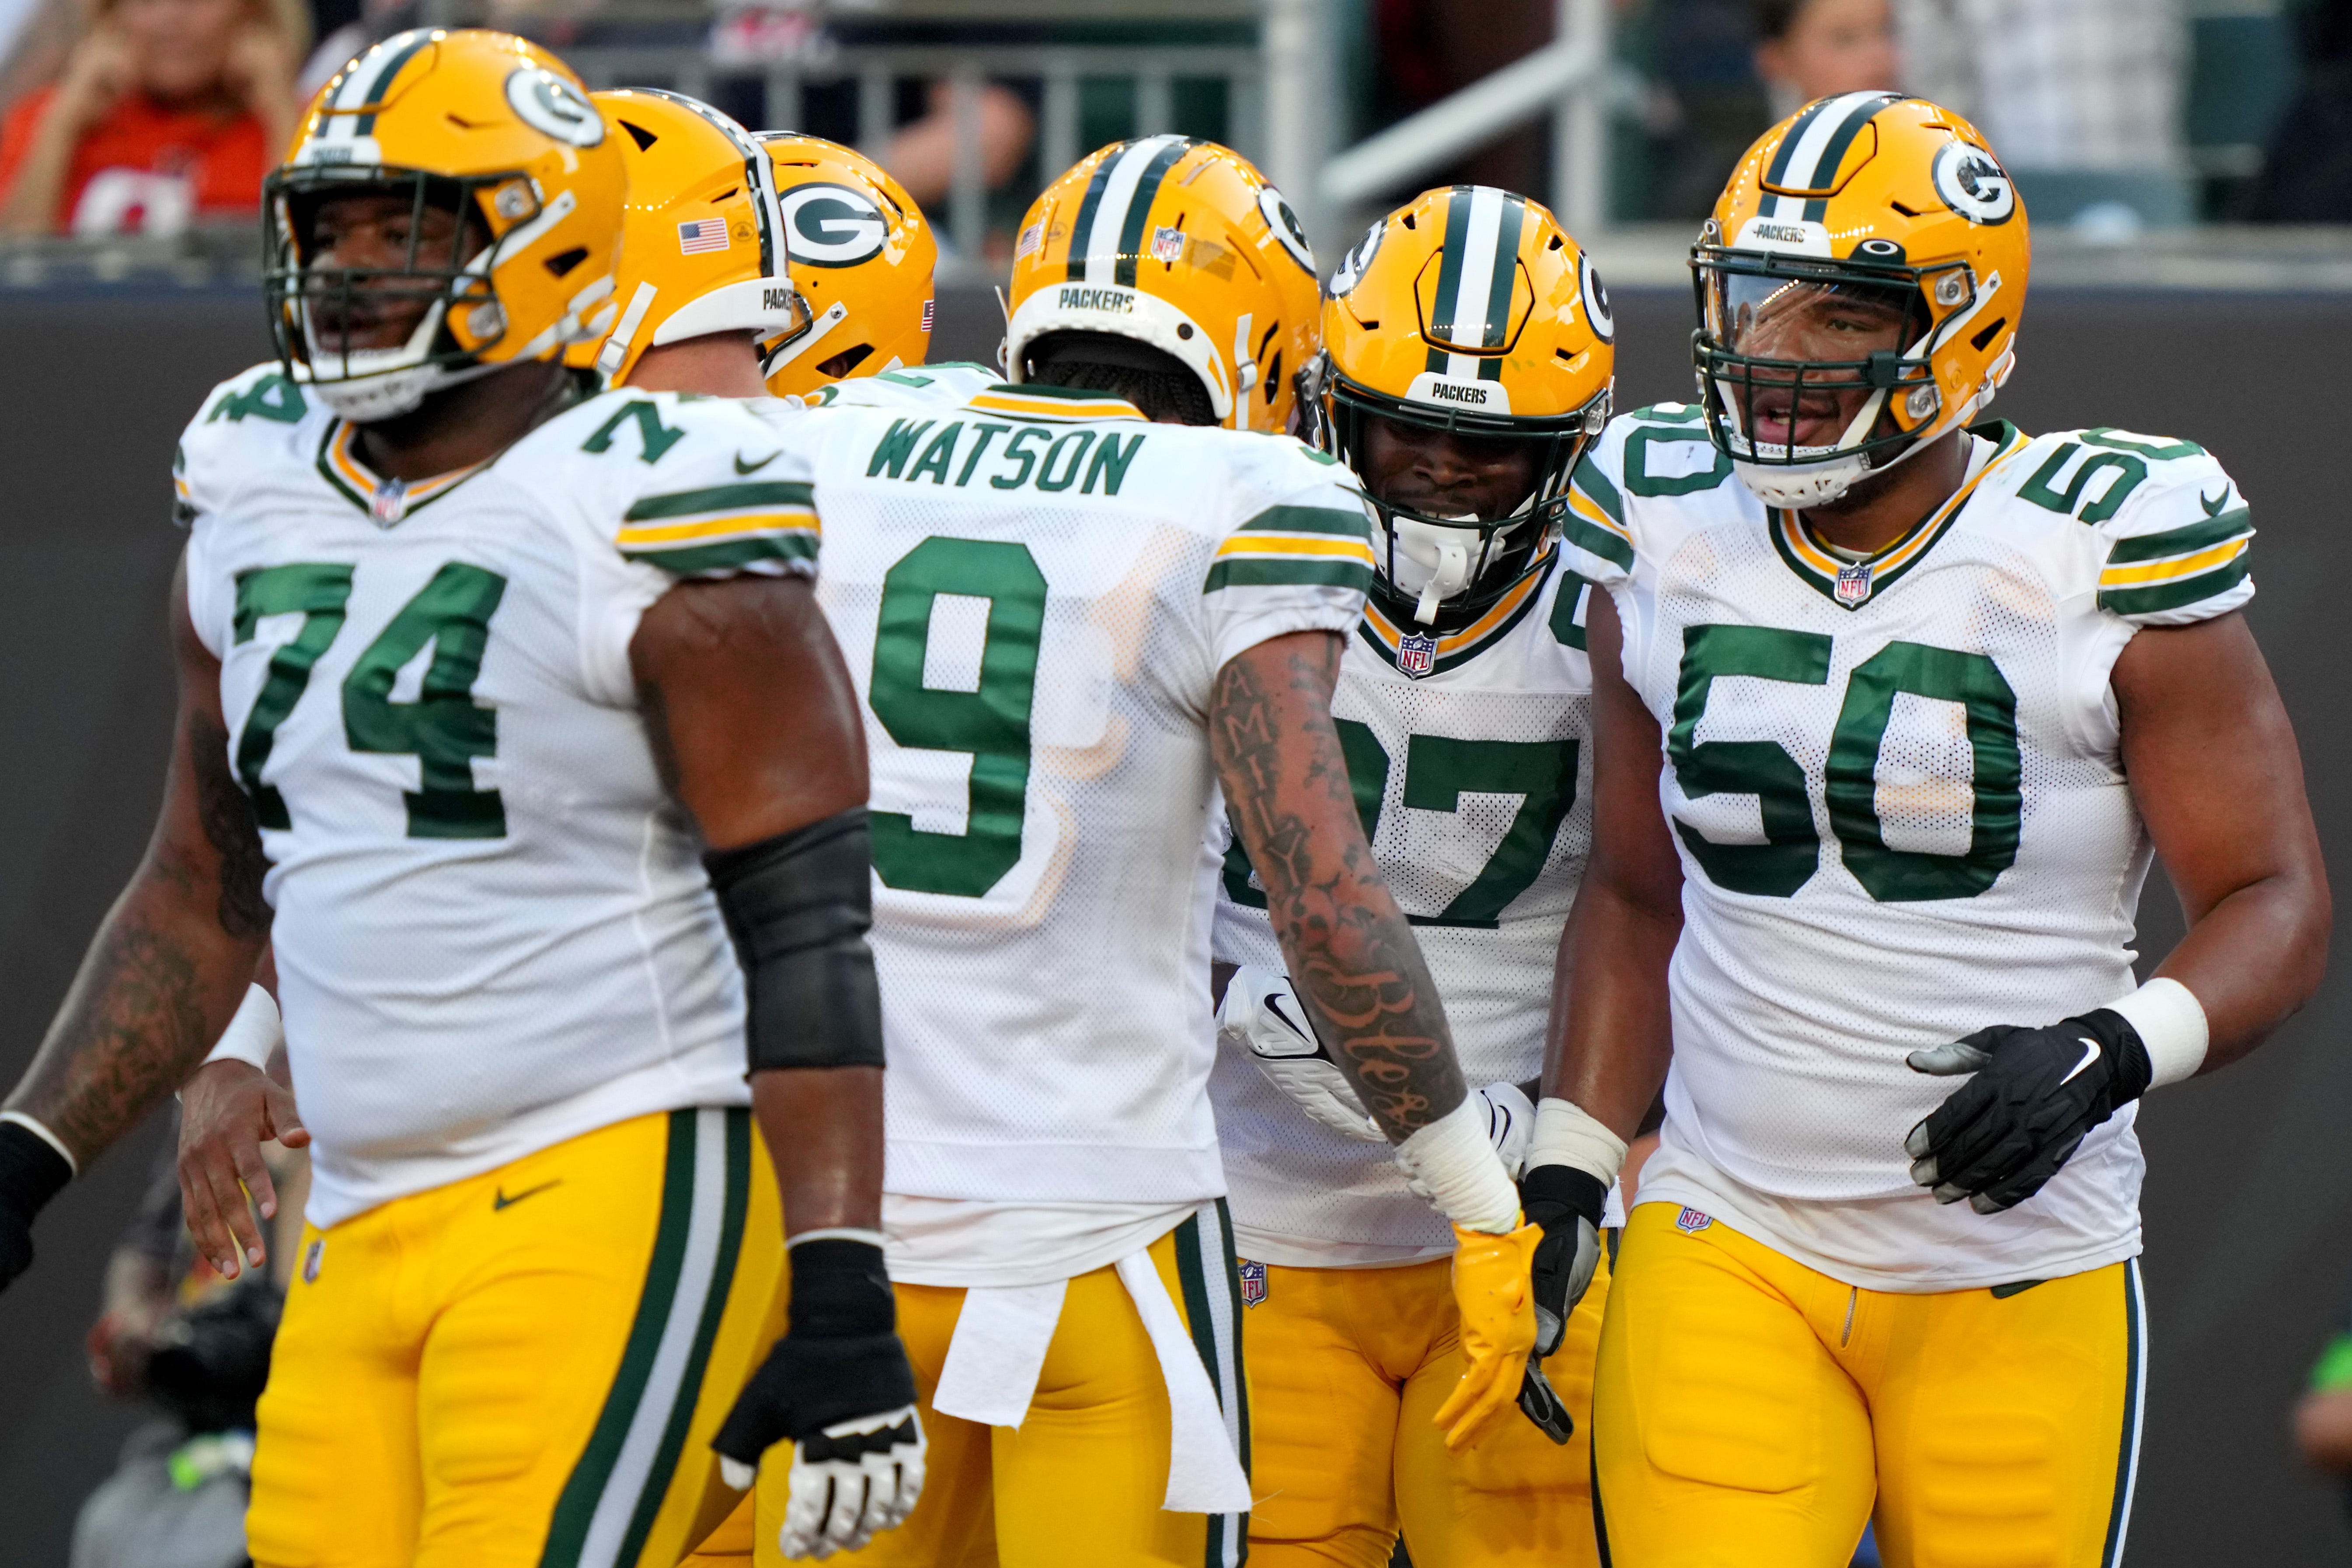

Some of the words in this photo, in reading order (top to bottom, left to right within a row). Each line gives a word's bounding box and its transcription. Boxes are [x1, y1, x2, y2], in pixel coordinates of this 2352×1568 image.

[780, 184, 888, 265] G
[763, 288, 793, 310] PACKE
[1059, 288, 1135, 314] PACKERS
[1432, 381, 1487, 404] PACKERS
[866, 418, 1146, 495] WATSON
[1840, 579, 1866, 597] NFL
[1402, 650, 1428, 670] NFL
[233, 561, 509, 840] 74
[868, 535, 1049, 898] 9
[1220, 663, 1305, 888] AMILY
[1667, 624, 2023, 902] 50
[1682, 1211, 1706, 1227] NFL
